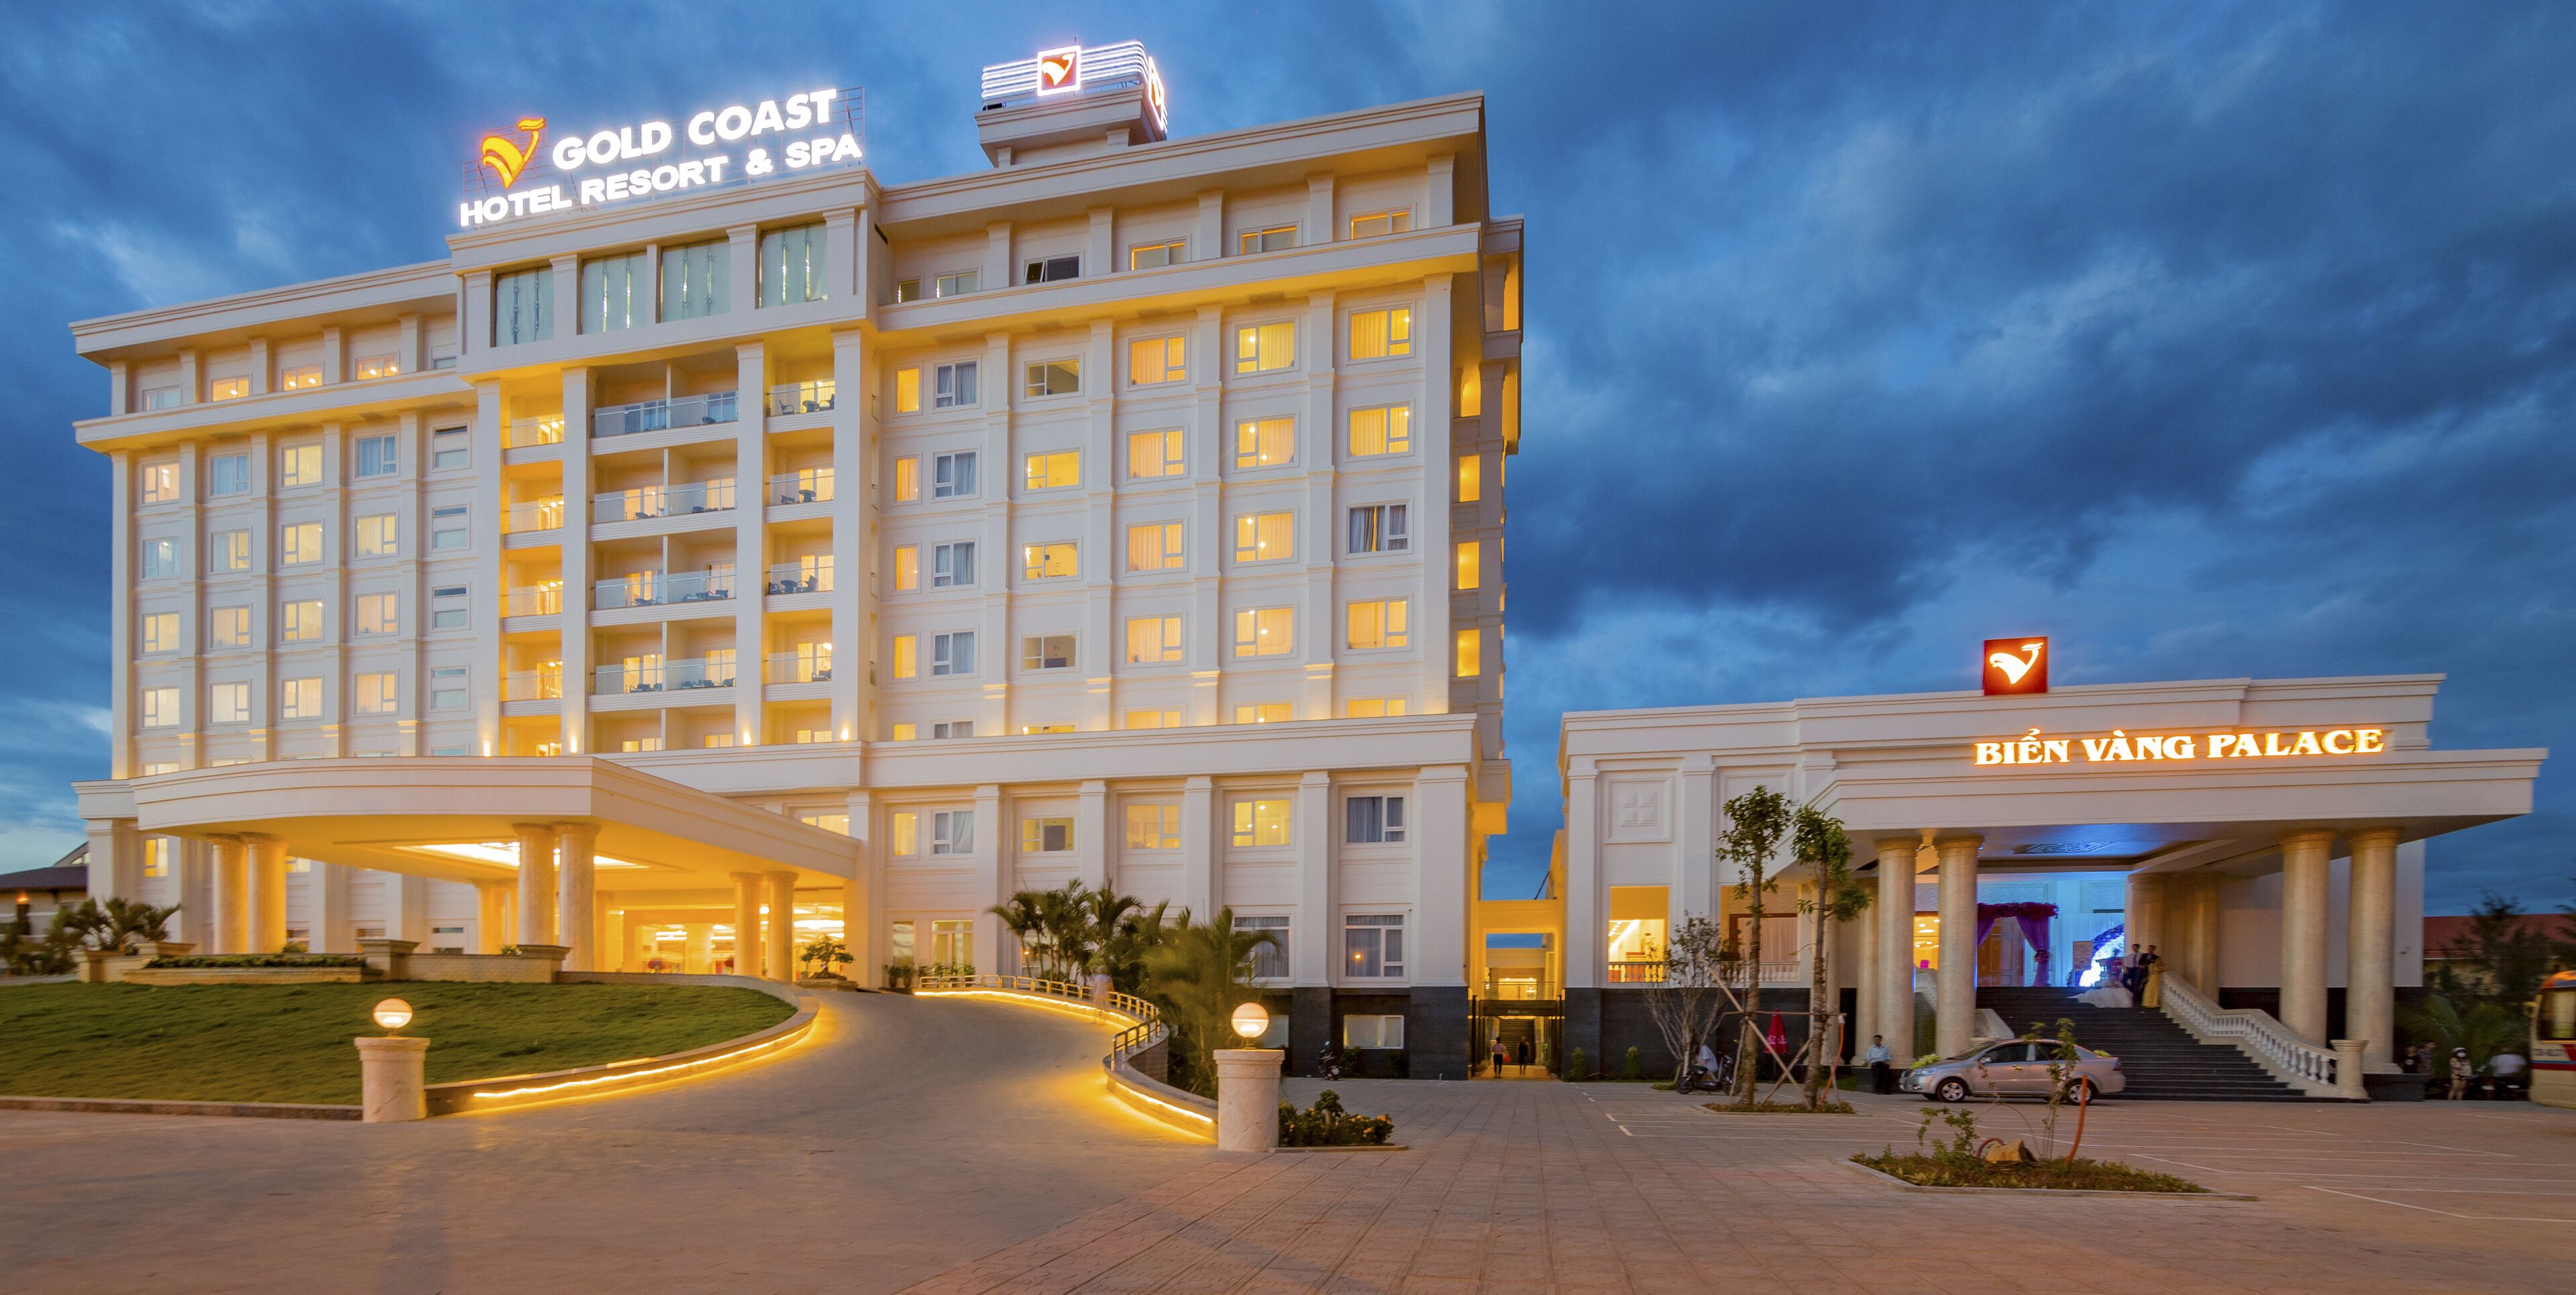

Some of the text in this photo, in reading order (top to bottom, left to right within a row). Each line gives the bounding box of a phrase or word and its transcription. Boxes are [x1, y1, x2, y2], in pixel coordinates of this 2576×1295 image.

[552, 89, 837, 170] GOLD COAST
[460, 133, 863, 227] HOTEL RESORT & SPA
[1974, 728, 2385, 765] BIỂN VÀNG PALACE
